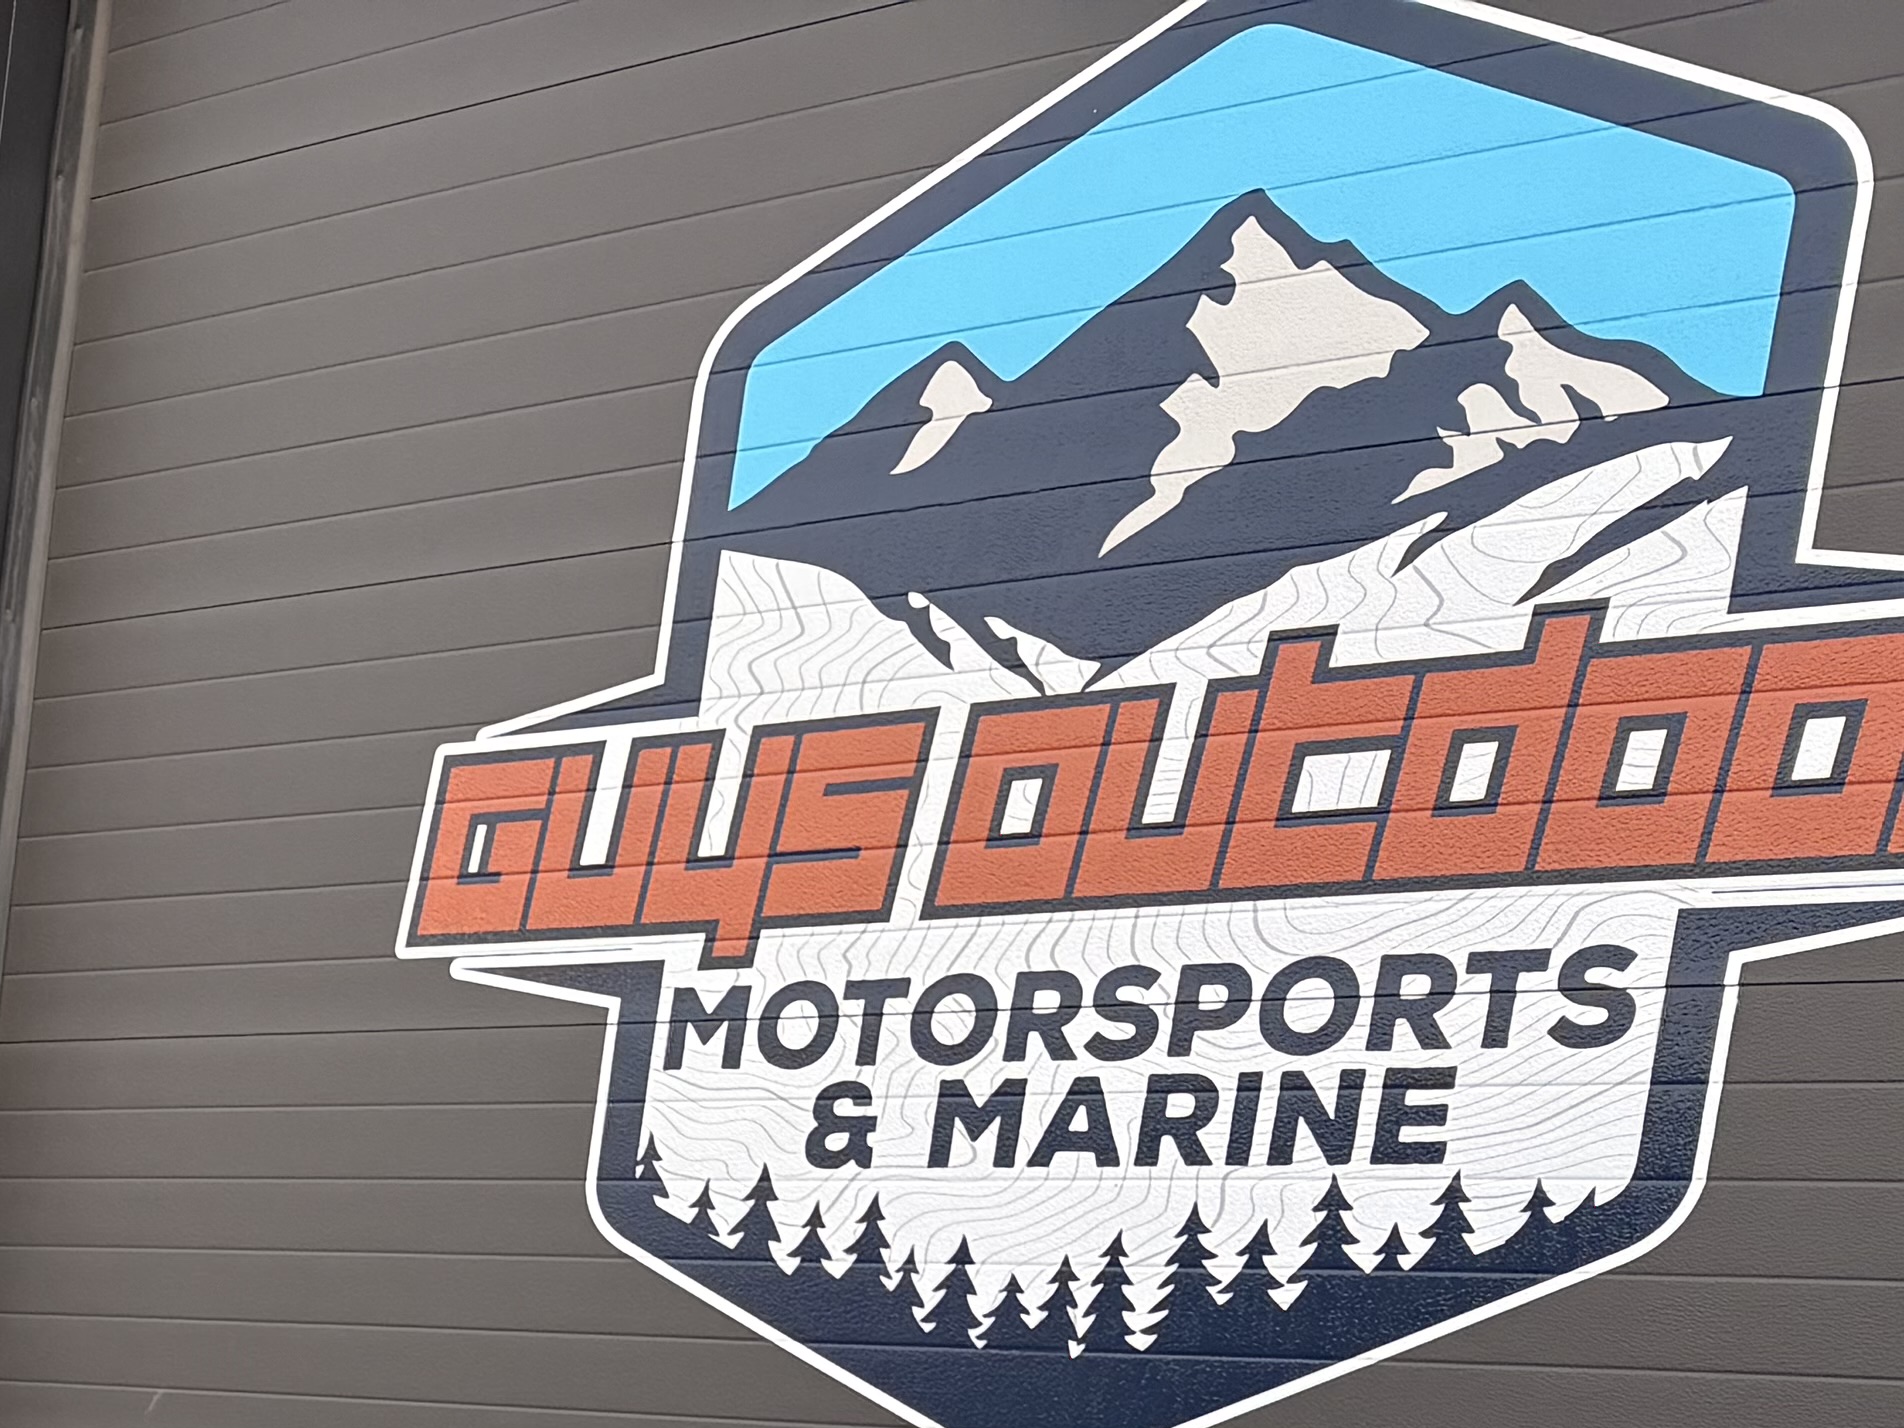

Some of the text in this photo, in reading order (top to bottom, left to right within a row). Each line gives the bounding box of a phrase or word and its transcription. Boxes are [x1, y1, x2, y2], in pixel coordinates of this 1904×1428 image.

[662, 943, 1639, 1072] MOTORSPORTS
[804, 1065, 1459, 1170] & MARINE
